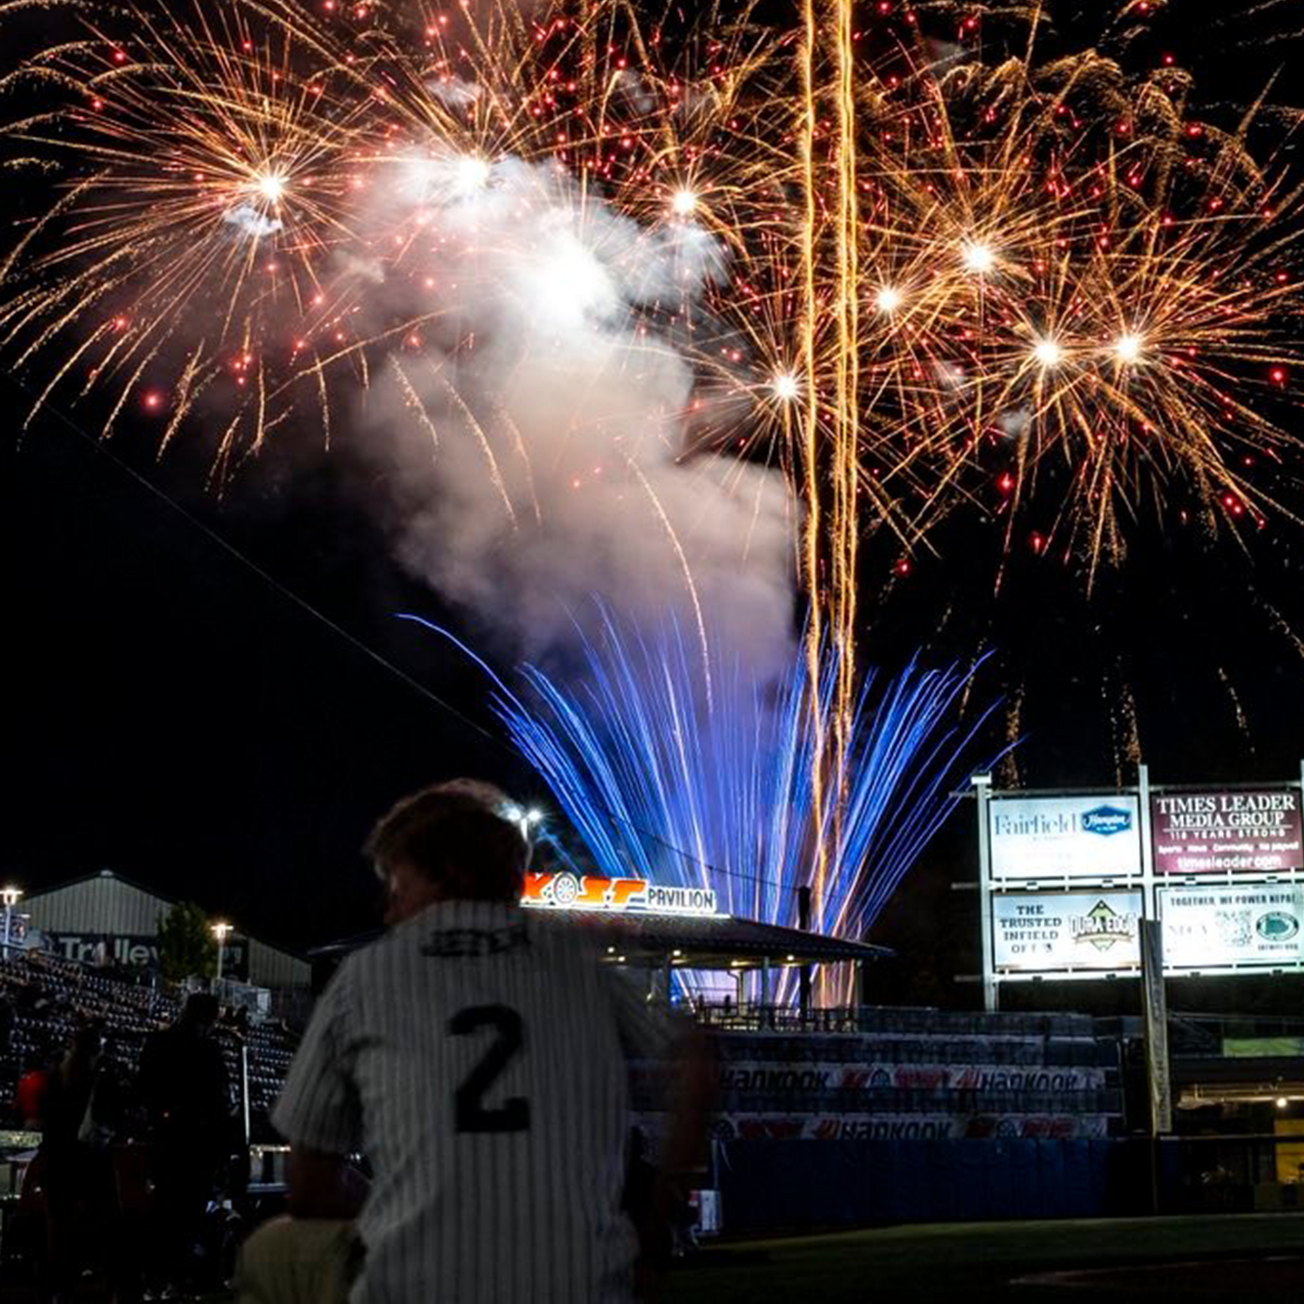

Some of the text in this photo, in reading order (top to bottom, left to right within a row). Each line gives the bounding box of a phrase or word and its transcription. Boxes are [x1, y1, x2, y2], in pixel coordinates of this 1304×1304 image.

[1157, 795, 1295, 814] TIMES LEADER
[995, 813, 1076, 835] Fairfield
[1170, 811, 1284, 828] MEDIA GROUP
[1194, 830, 1232, 839] YEARS
[647, 889, 714, 910] PAVILION
[1236, 894, 1267, 905] POWER
[1016, 904, 1044, 915] THE
[999, 917, 1062, 928] TRUSTED
[1003, 930, 1058, 941] INFIELD
[448, 1004, 531, 1134] 2
